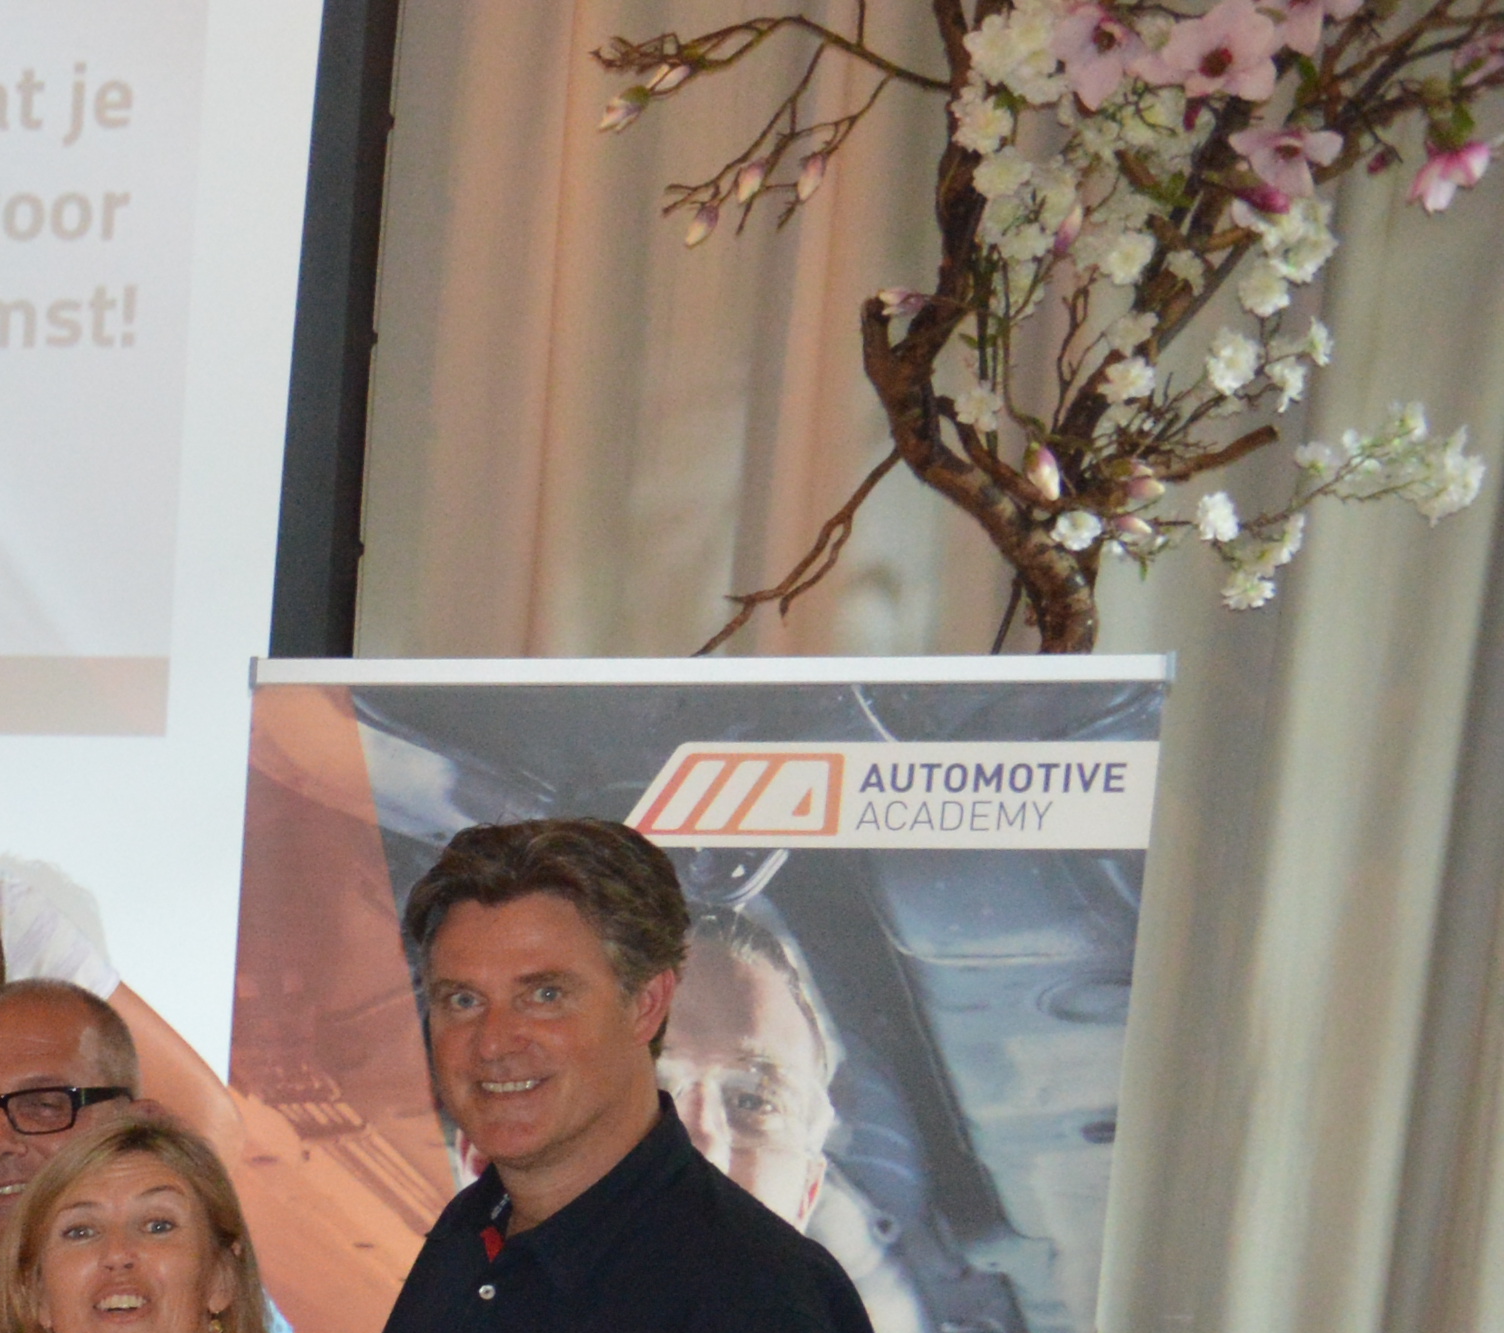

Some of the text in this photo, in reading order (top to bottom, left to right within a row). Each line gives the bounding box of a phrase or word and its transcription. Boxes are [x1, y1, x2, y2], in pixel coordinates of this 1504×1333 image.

[63, 61, 136, 147] je
[859, 762, 1129, 794] AUTOMOTIVE
[855, 800, 1055, 832] ACADEMY
